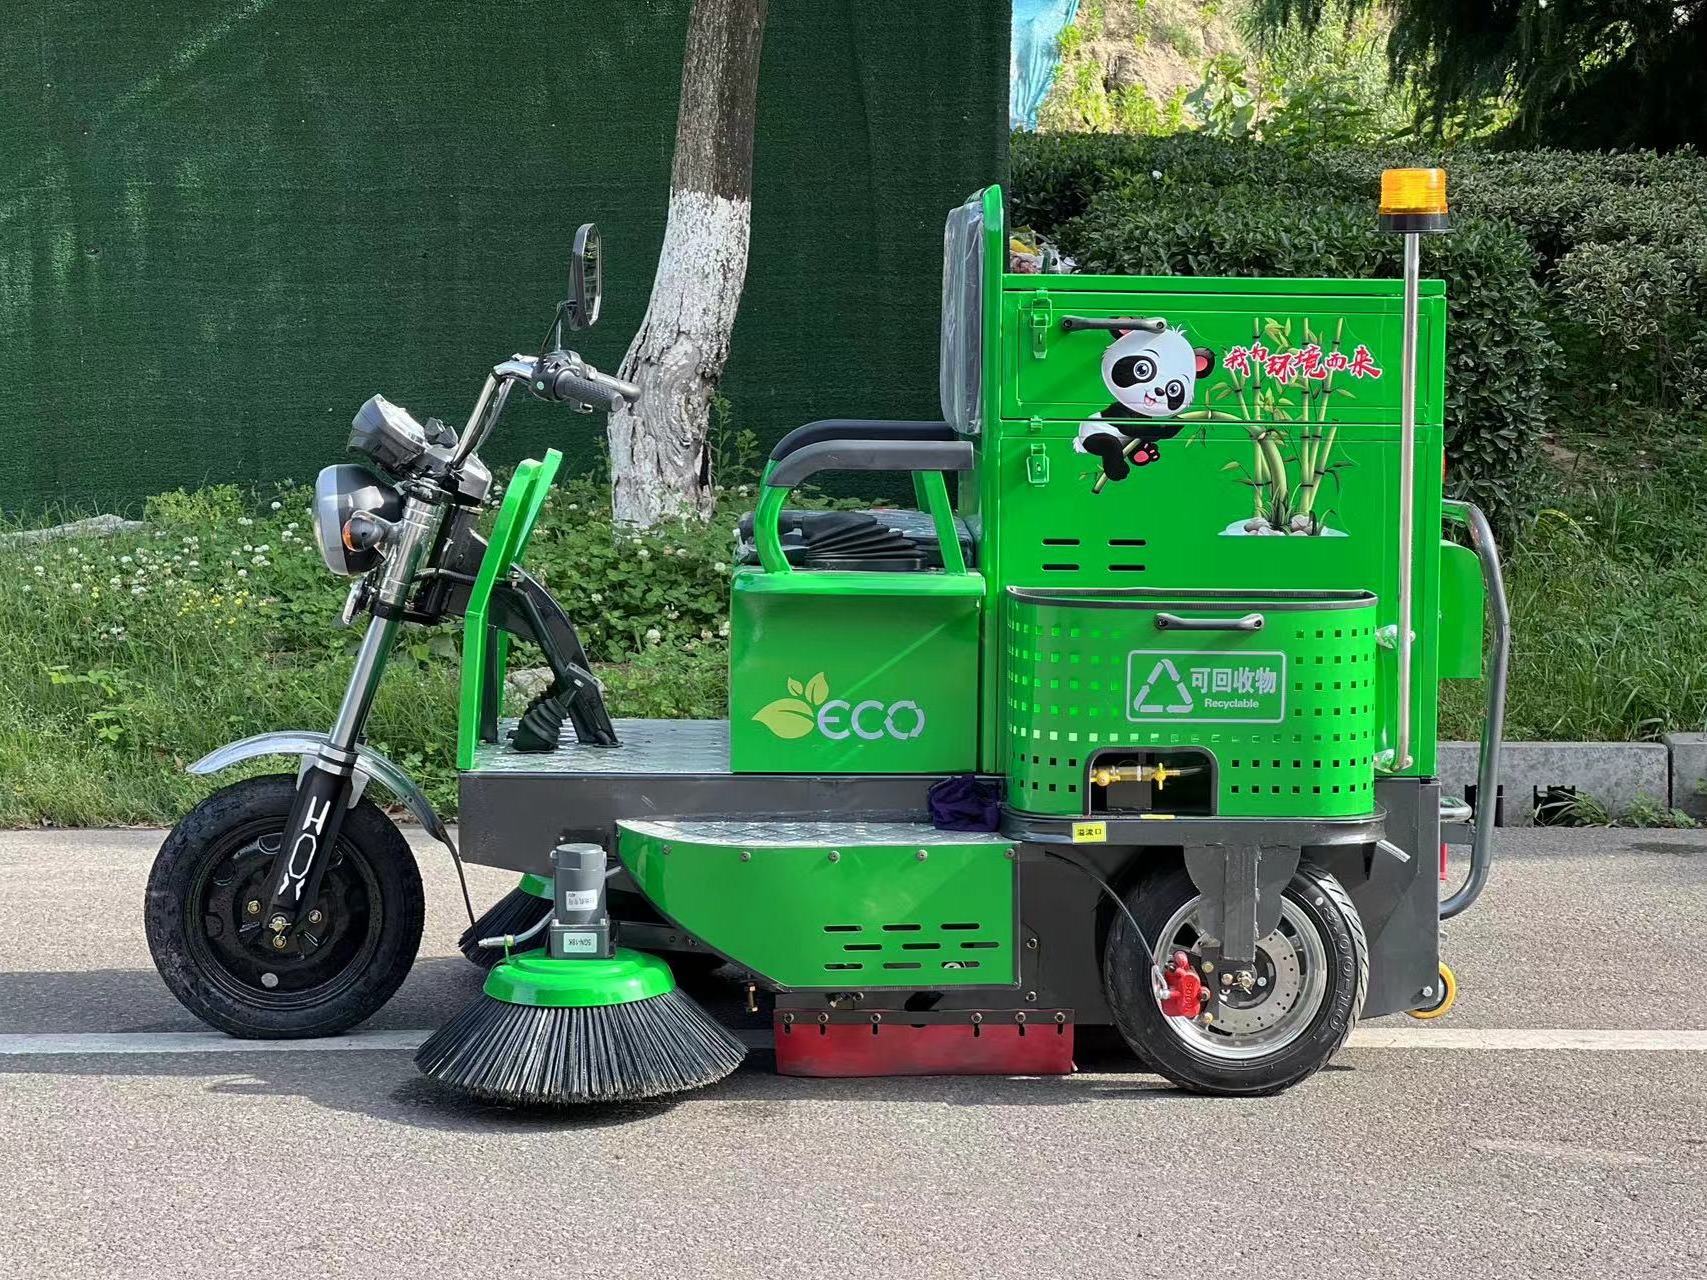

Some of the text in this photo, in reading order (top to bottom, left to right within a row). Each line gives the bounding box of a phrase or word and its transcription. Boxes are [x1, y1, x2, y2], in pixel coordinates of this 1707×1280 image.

[1223, 342, 1383, 385] 我为环境而来
[1190, 667, 1277, 695] 可回收物
[817, 699, 926, 741] ECO
[1204, 698, 1260, 710] Recyclable
